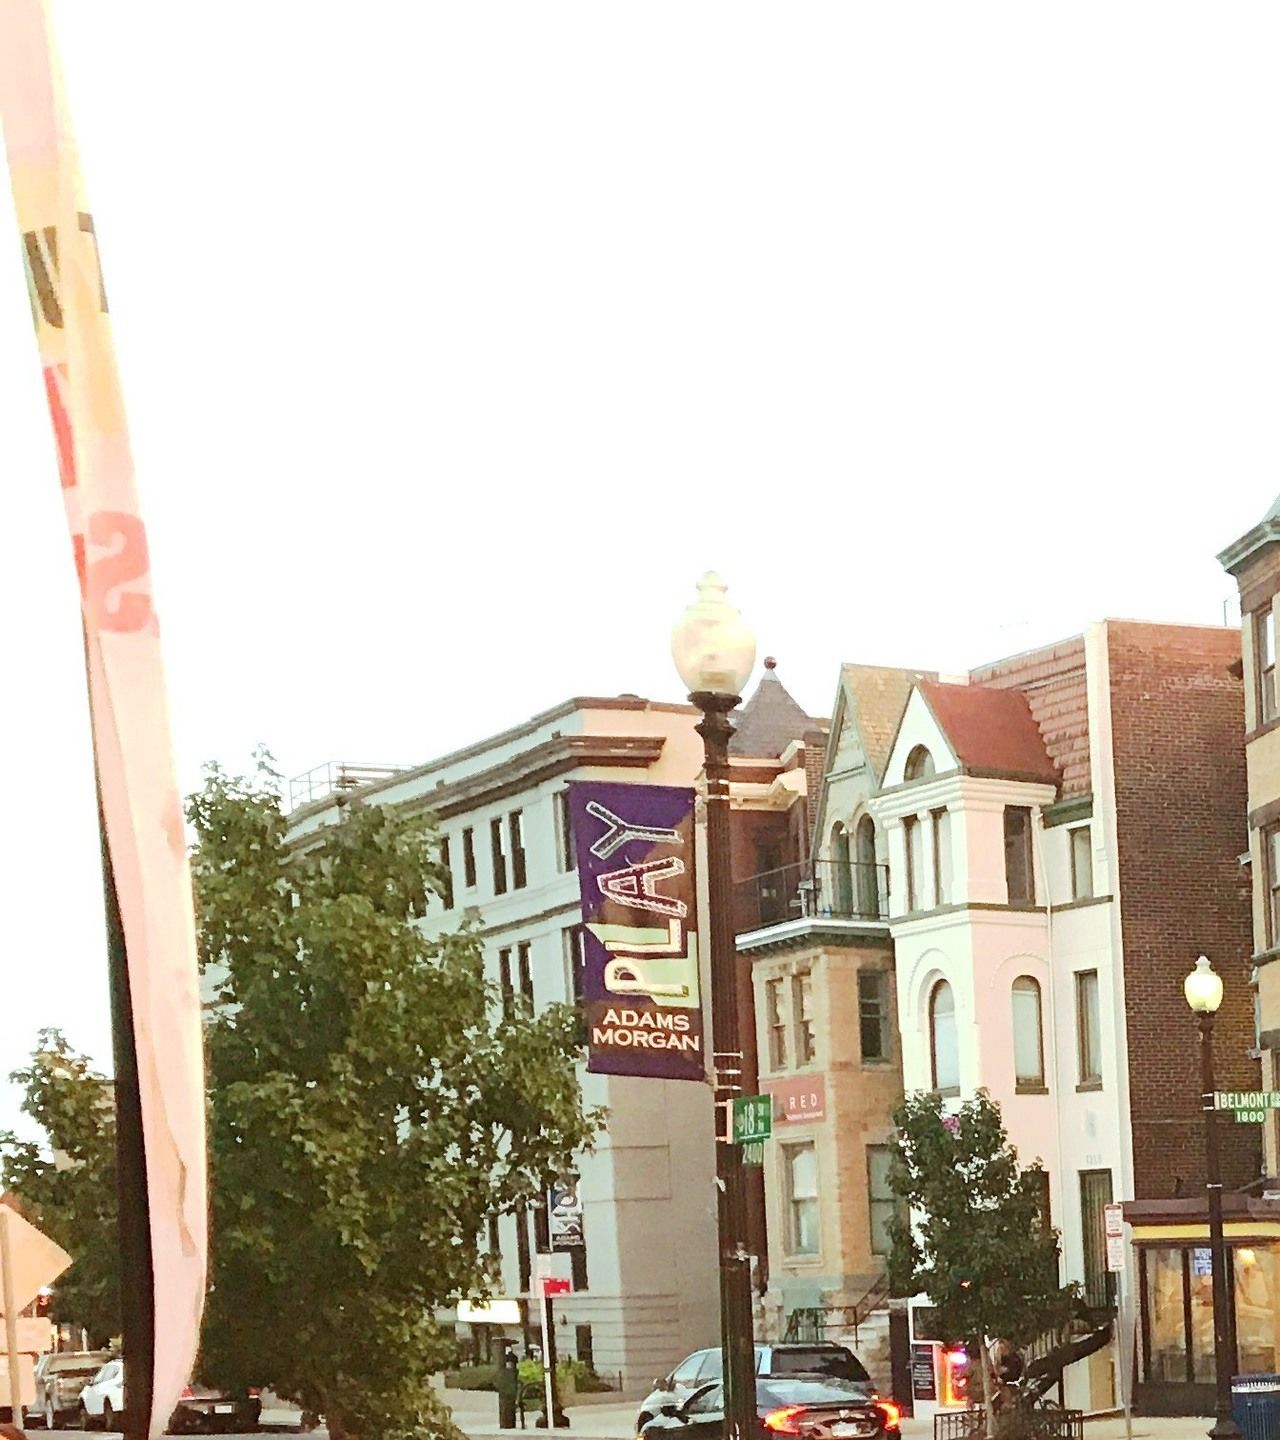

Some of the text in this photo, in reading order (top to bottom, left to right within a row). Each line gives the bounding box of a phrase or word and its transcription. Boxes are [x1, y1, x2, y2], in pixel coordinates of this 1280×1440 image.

[586, 800, 689, 997] PLAY
[602, 1008, 690, 1032] ADAMS
[592, 1027, 700, 1051] MORGAN
[789, 1093, 818, 1110] RED
[1220, 1092, 1269, 1109] BELMONT
[1236, 1111, 1265, 1123] 1800
